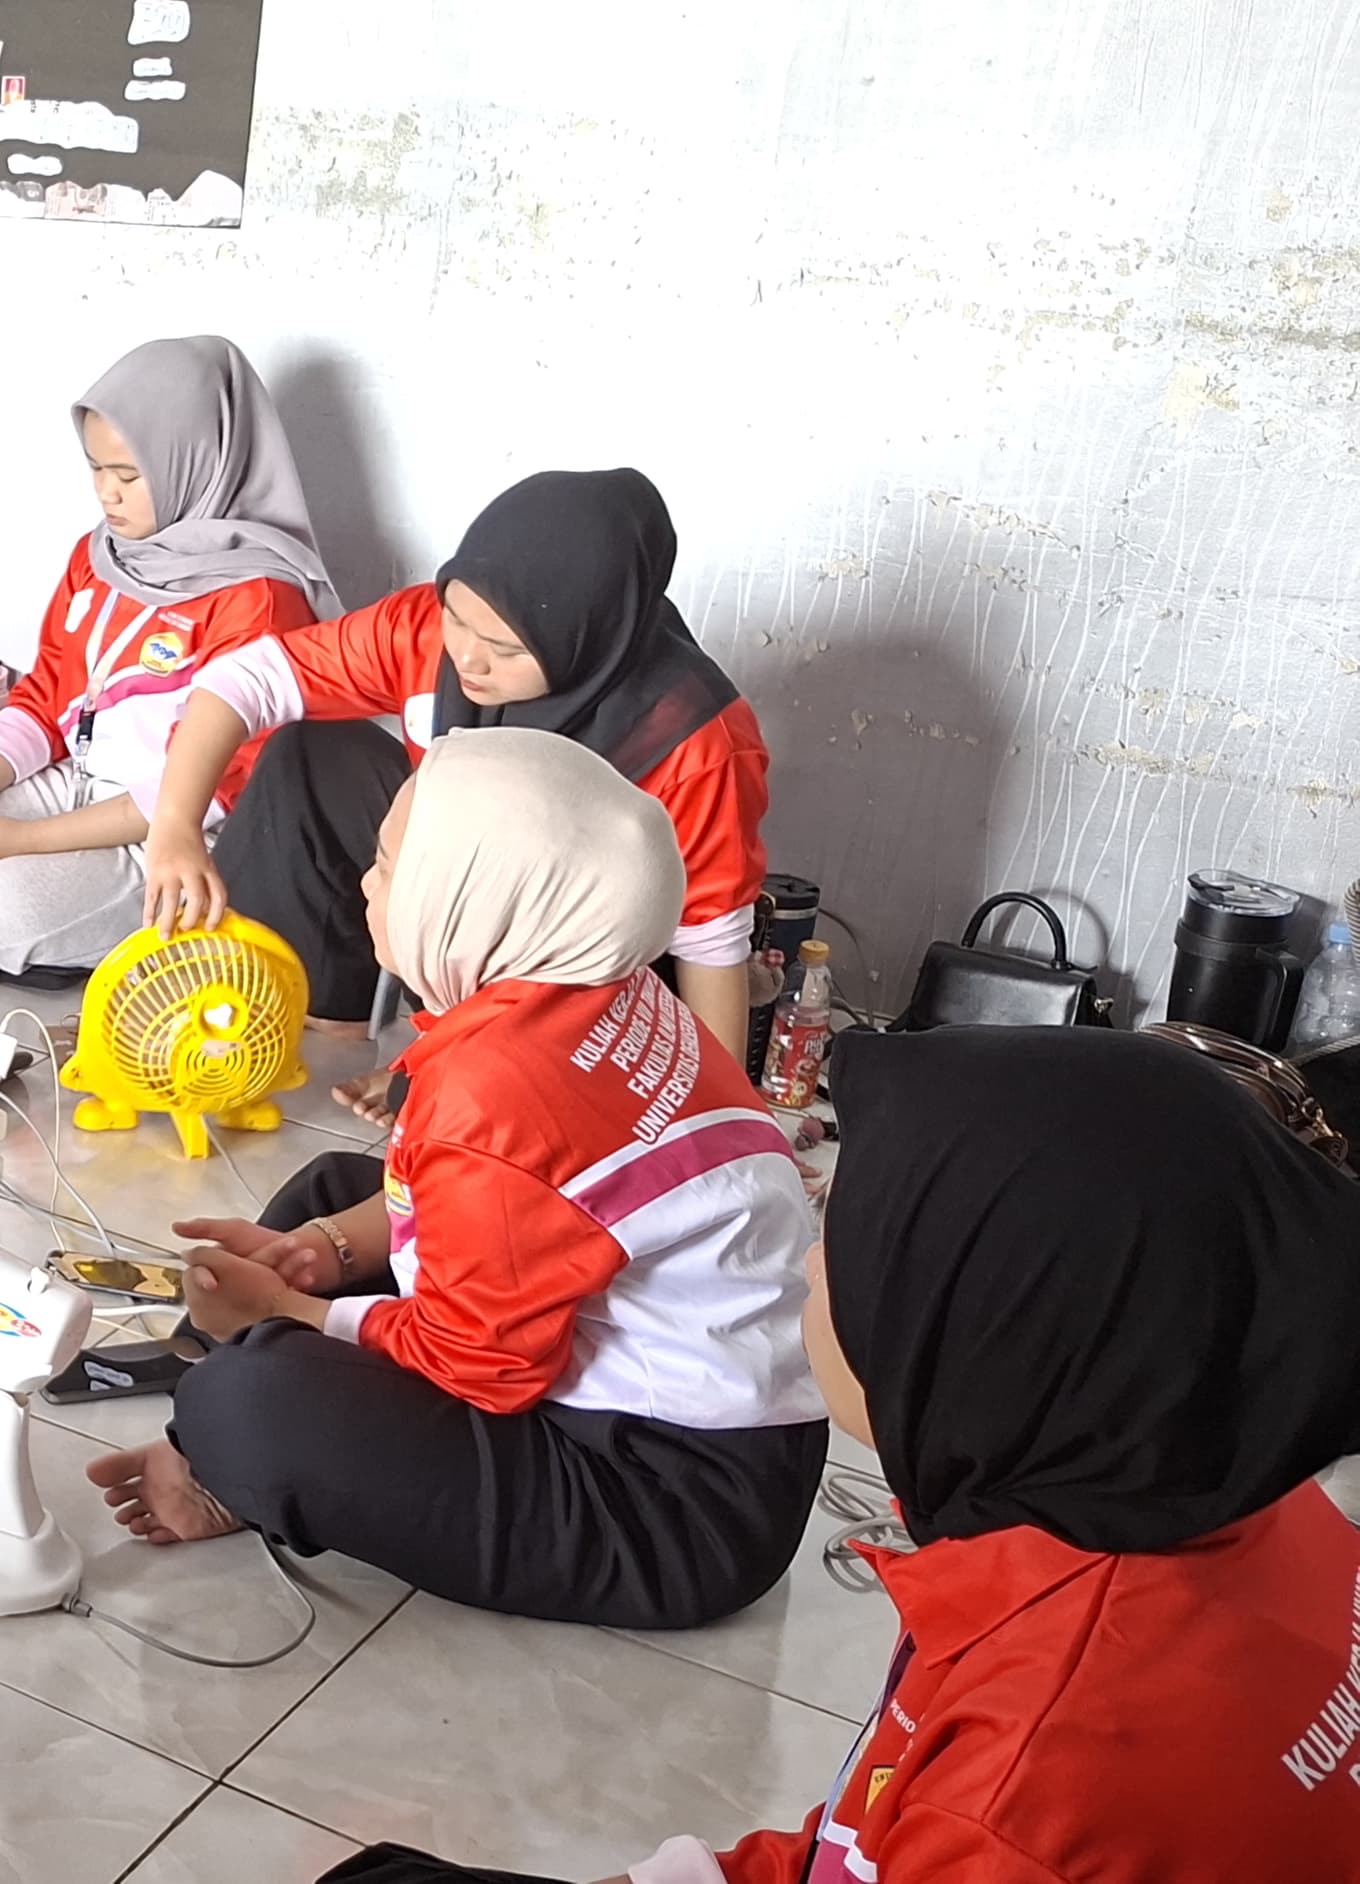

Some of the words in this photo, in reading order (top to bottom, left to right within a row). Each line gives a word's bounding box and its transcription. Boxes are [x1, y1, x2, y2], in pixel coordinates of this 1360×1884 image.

[569, 1013, 620, 1073] KULIAH
[609, 1014, 651, 1073] PERIODE
[627, 1033, 674, 1099] FAKULTAS
[632, 1052, 700, 1144] UNIVERSITAS
[1281, 1682, 1360, 1792] KULIAH
